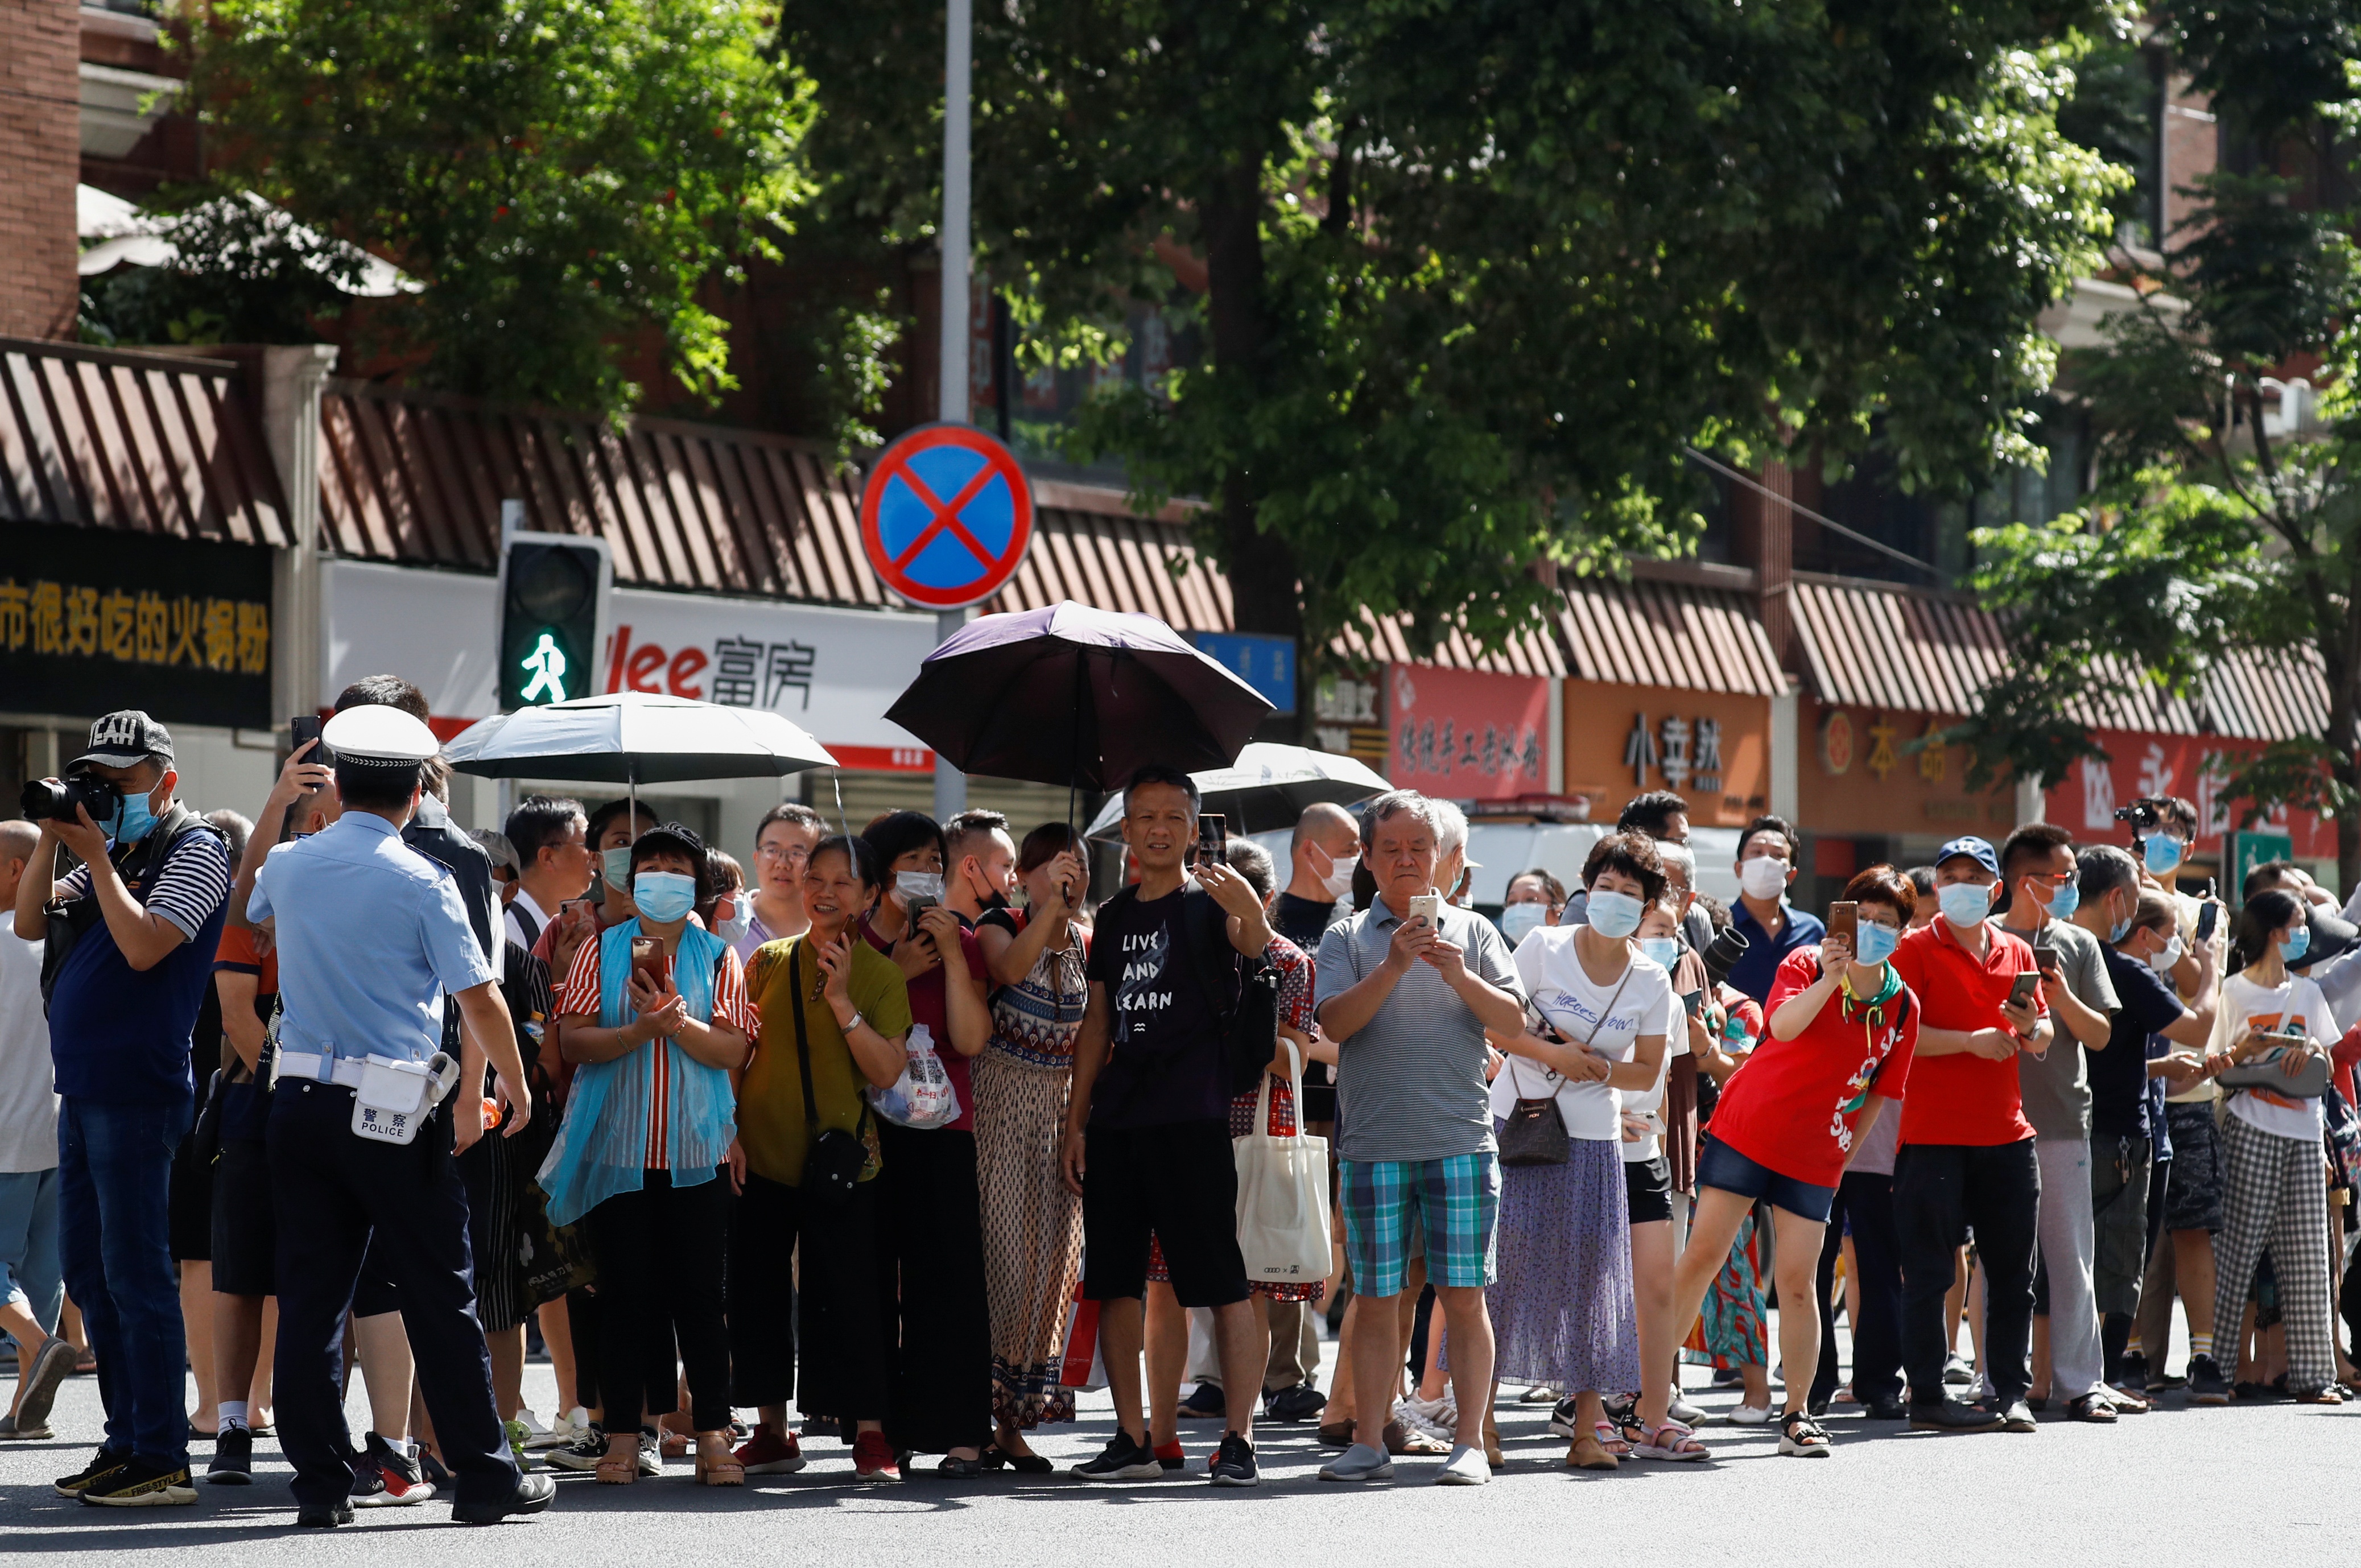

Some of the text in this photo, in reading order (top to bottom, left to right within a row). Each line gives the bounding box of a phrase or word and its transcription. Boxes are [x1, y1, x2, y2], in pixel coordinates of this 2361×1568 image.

[713, 634, 816, 712] 富房
[88, 717, 137, 749] YEAH
[1122, 931, 1158, 951] LIVE
[1122, 962, 1159, 981] AND
[1116, 992, 1172, 1011] LEARN
[364, 1108, 406, 1128] 警察
[362, 1122, 404, 1137] POLICE
[131, 1473, 179, 1497] FREE-STYLE
